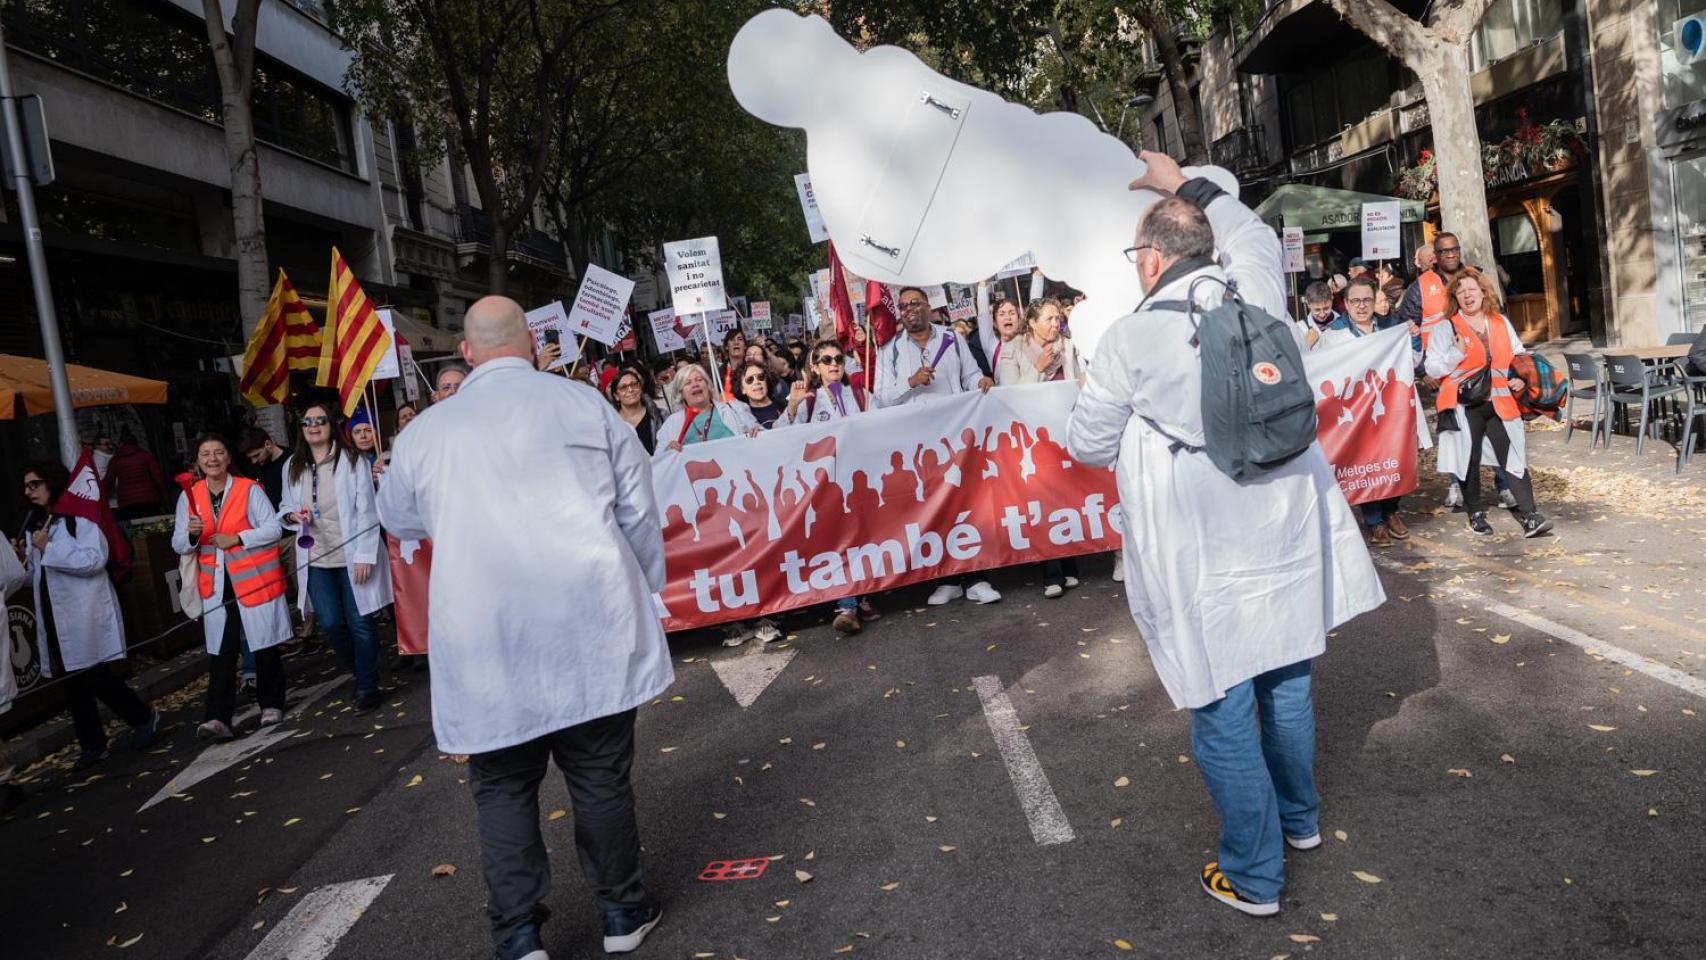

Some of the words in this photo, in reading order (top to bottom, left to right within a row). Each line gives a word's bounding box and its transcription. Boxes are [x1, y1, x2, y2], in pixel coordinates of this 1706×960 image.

[1321, 212, 1360, 225] ASADOR
[677, 249, 707, 258] Volem
[677, 259, 711, 270] sanitat
[686, 272, 690, 280] i
[693, 272, 704, 280] no
[674, 279, 720, 293] precarietat
[529, 313, 559, 328] Conveni
[1337, 463, 1380, 479] Metges
[1383, 458, 1399, 469] de
[1339, 472, 1400, 491] Catalunya
[690, 568, 760, 612] tu
[780, 510, 982, 595] també
